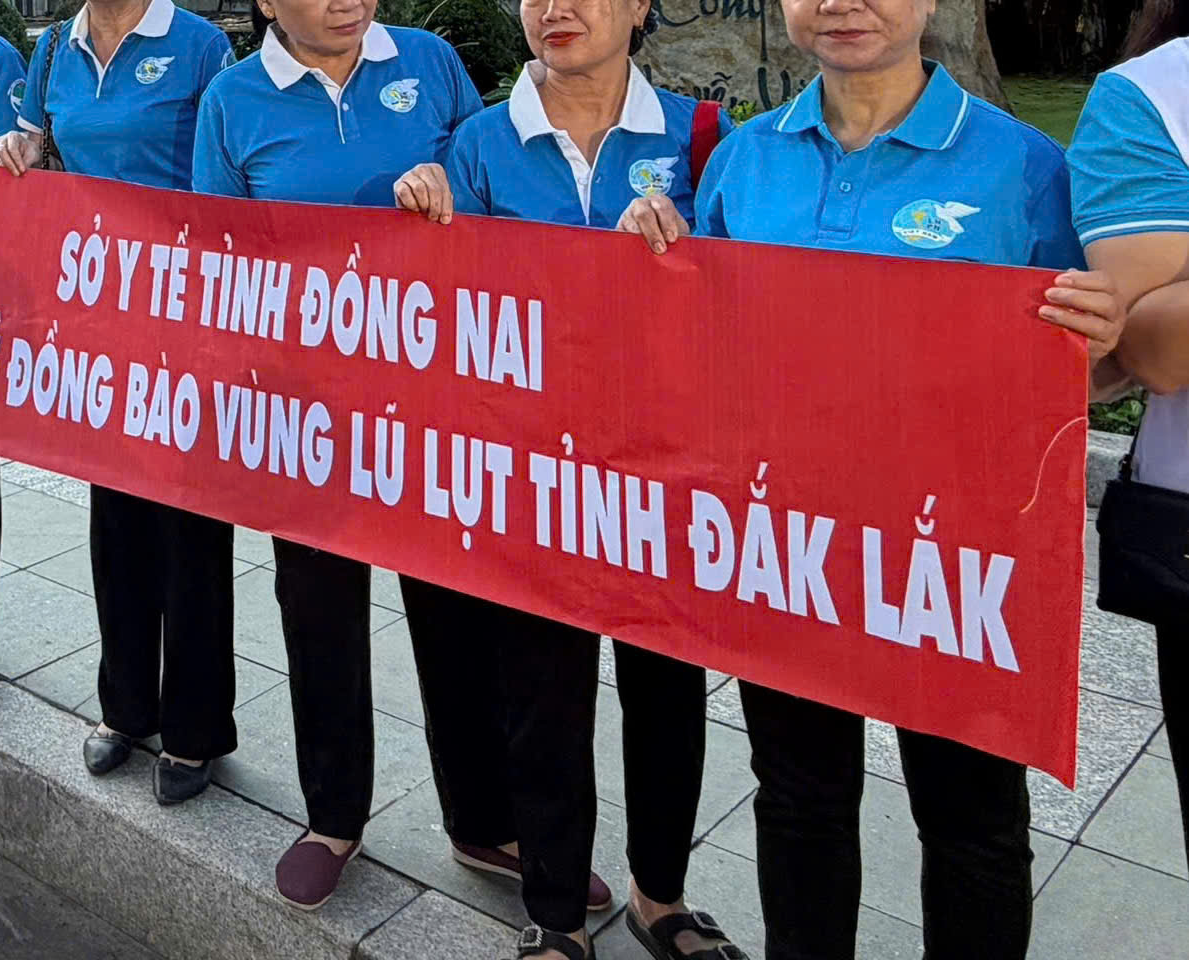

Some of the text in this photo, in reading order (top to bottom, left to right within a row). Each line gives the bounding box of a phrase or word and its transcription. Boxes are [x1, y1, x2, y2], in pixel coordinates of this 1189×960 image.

[57, 213, 543, 393] SỞ Y TẾ TỈNH ĐỒNG NAI
[5, 319, 115, 430] ĐỒNG
[122, 350, 201, 453] BÀO
[213, 368, 334, 487] VÙNG
[349, 402, 405, 506] LŨ
[424, 427, 513, 551] LỤT
[529, 432, 668, 579] TỈNH
[687, 461, 840, 626] ĐẮK
[862, 495, 1021, 673] LẮK
